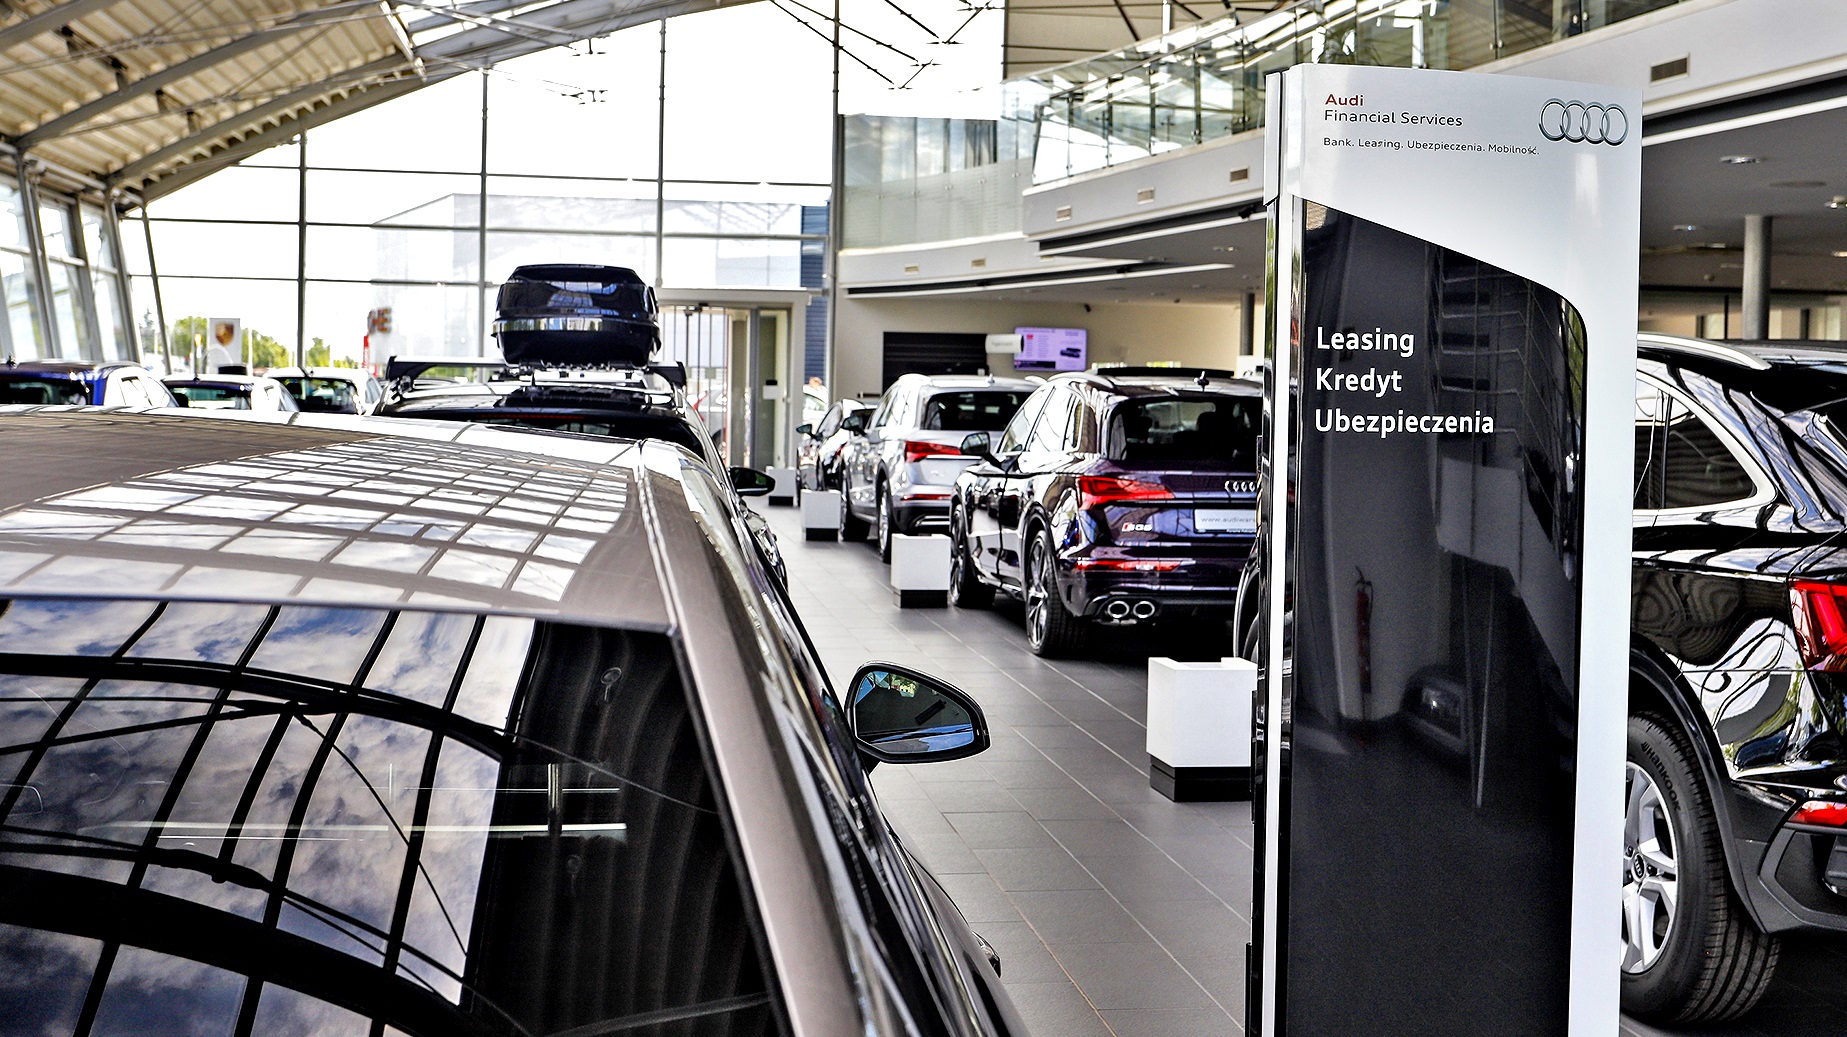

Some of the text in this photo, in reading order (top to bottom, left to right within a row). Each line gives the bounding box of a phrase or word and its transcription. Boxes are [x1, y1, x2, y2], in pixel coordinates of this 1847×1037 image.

[1325, 93, 1364, 106] Audi
[1324, 109, 1463, 126] Financial Services
[1323, 137, 1355, 147] Bank.
[1358, 138, 1404, 150] Leasing.
[1407, 140, 1486, 153] Ubezpieczenia.
[1316, 326, 1415, 358] Leasing
[1315, 367, 1403, 398] Kredyt
[1315, 408, 1495, 439] Ubezpieczenia
